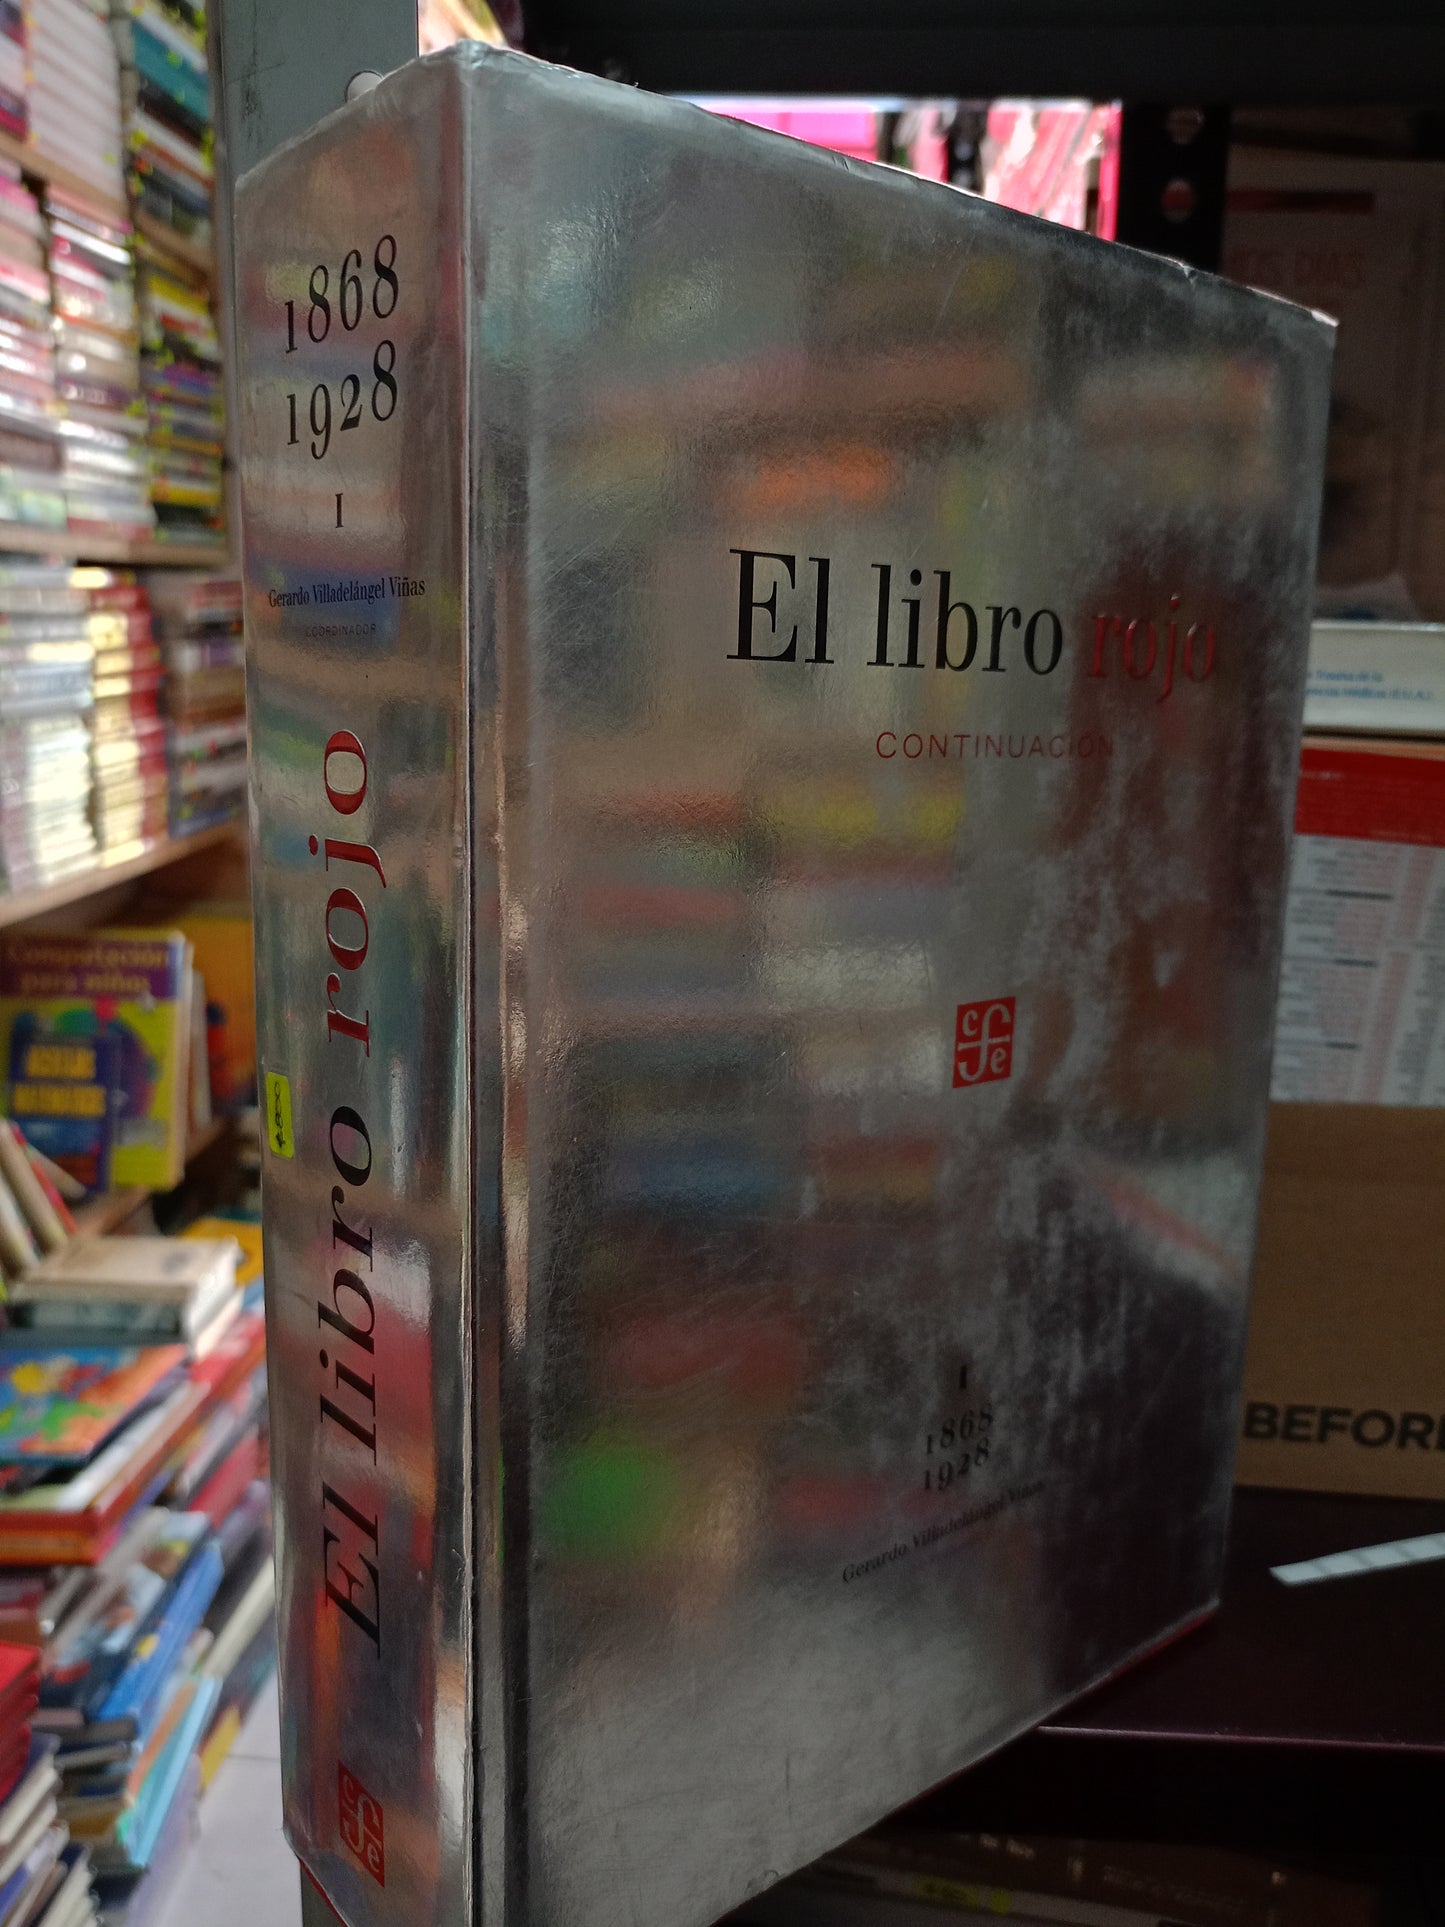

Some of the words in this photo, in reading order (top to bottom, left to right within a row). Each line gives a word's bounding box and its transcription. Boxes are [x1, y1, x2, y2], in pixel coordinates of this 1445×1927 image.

[285, 235, 399, 354] 1868
[286, 340, 399, 459] 1928
[268, 586, 310, 608] Gerardo
[312, 578, 386, 605] Villadelángel
[388, 576, 426, 598] Viñas
[306, 623, 377, 639] COORDINADOR
[727, 549, 835, 665] El
[866, 563, 1064, 676] libro
[1087, 593, 1216, 703] rojo
[309, 728, 387, 1058] rojo
[318, 1104, 378, 1466] libro
[922, 1438, 990, 1491] 1928
[925, 1405, 993, 1455] 1868
[1243, 1401, 1445, 1451] BEFOR
[322, 1482, 383, 1658] El
[843, 1543, 907, 1583] Gerardo
